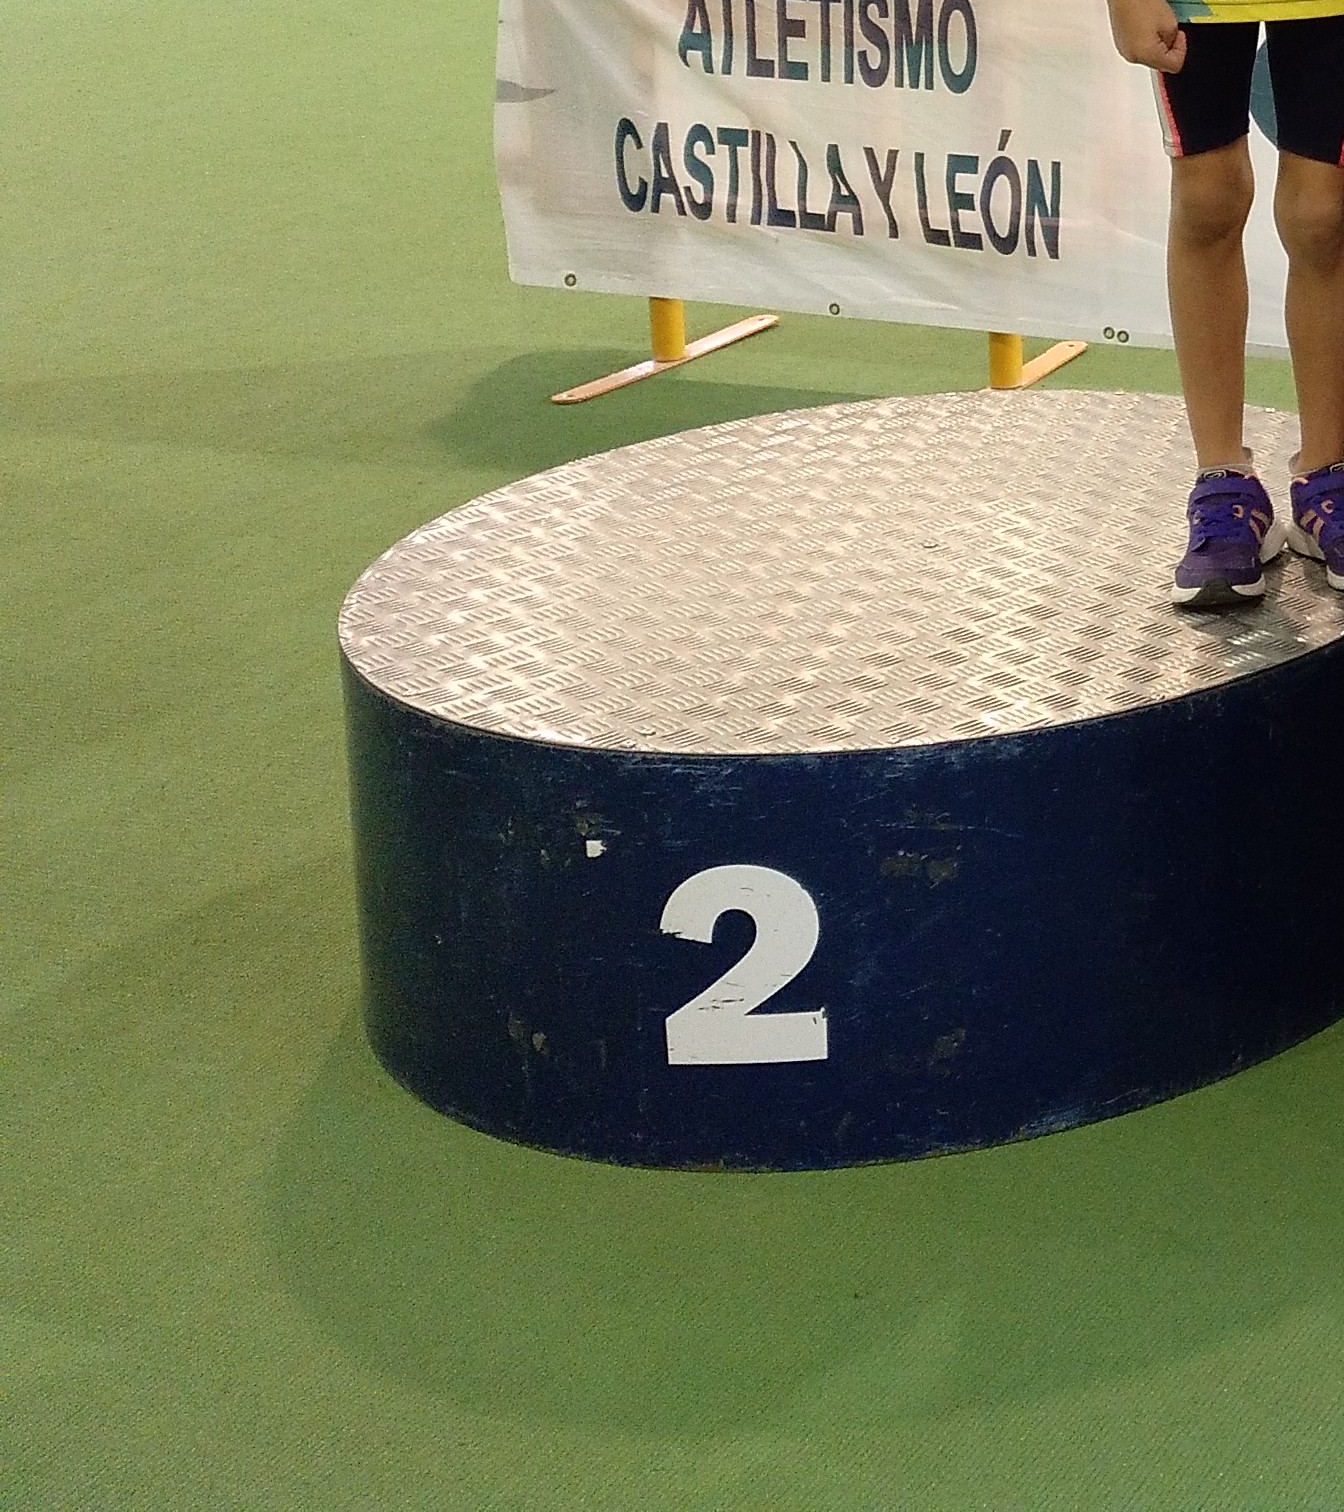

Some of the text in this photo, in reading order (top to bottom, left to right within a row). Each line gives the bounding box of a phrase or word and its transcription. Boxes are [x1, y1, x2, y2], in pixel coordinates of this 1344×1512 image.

[614, 117, 1061, 261] CASTILLA Y LEÓN
[659, 865, 828, 1065] 2
